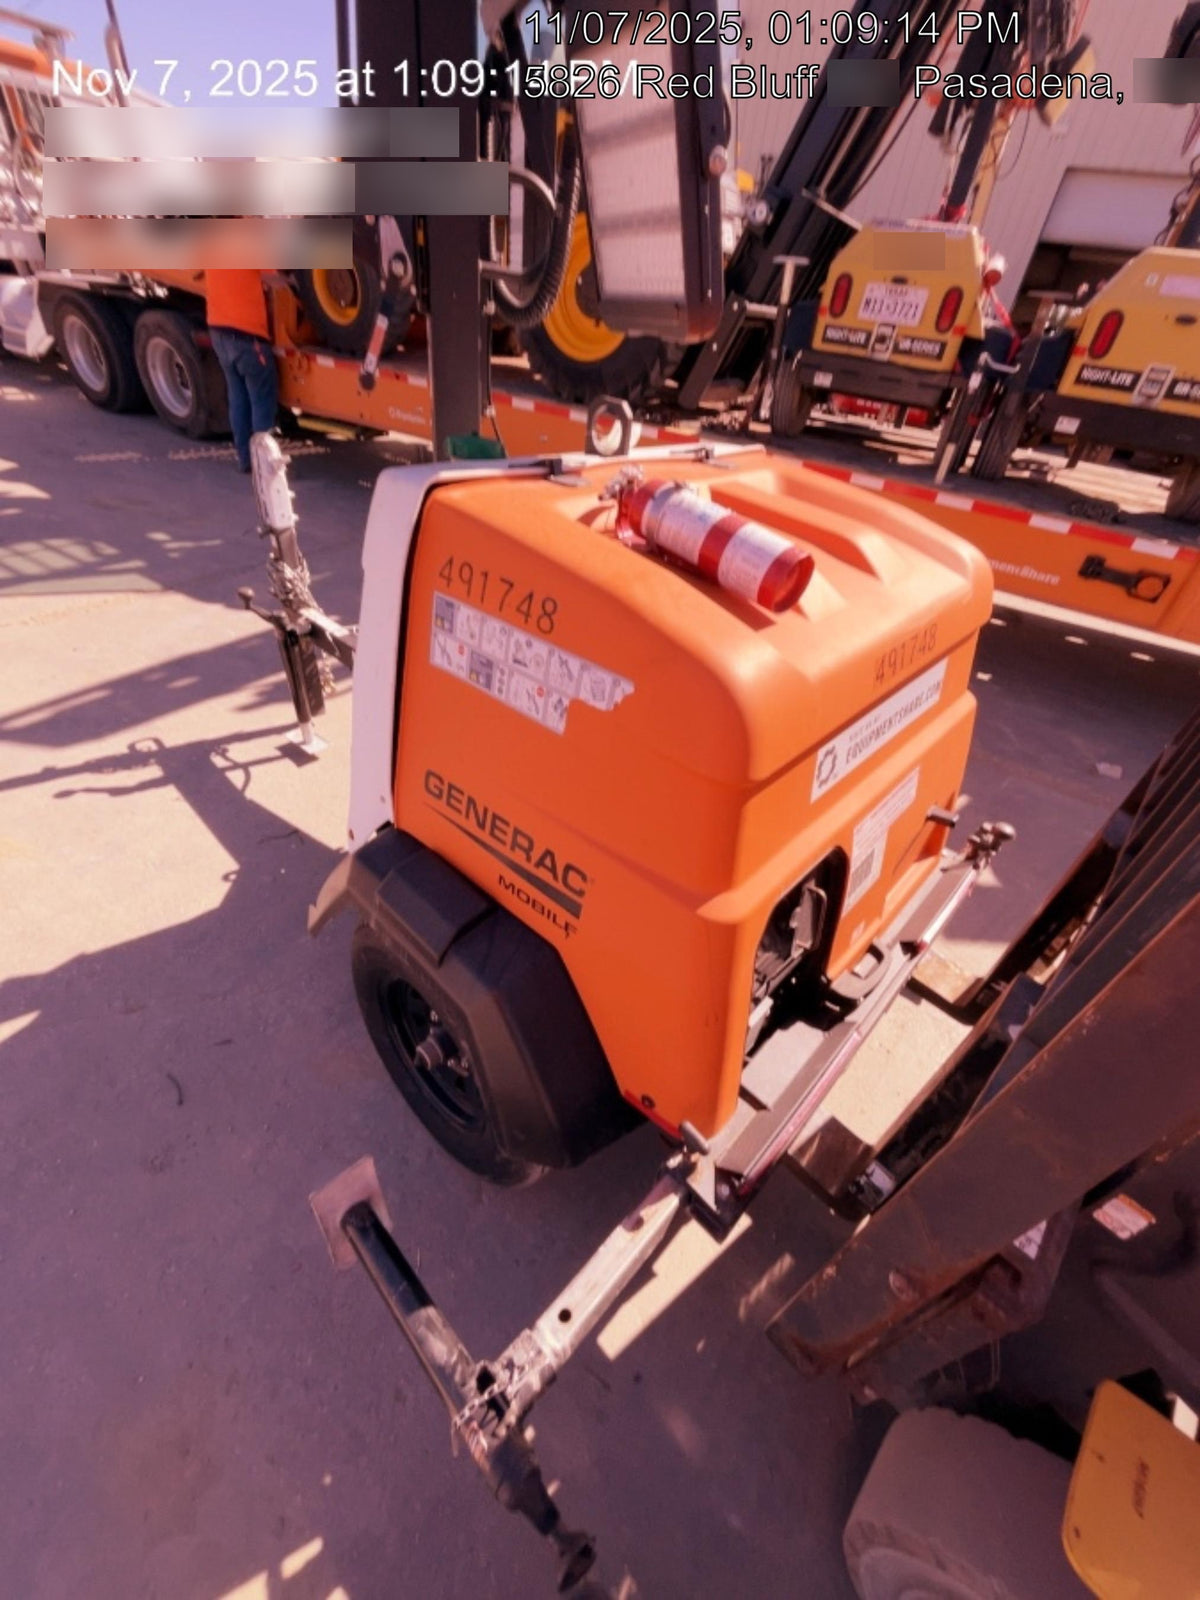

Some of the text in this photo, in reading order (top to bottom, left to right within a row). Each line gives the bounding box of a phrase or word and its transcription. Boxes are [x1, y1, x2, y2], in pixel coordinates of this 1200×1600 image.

[1080, 367, 1136, 387] NIGHT-LITE
[438, 555, 559, 635] 491748
[875, 622, 938, 685] 491748
[423, 768, 588, 899] GENERAC
